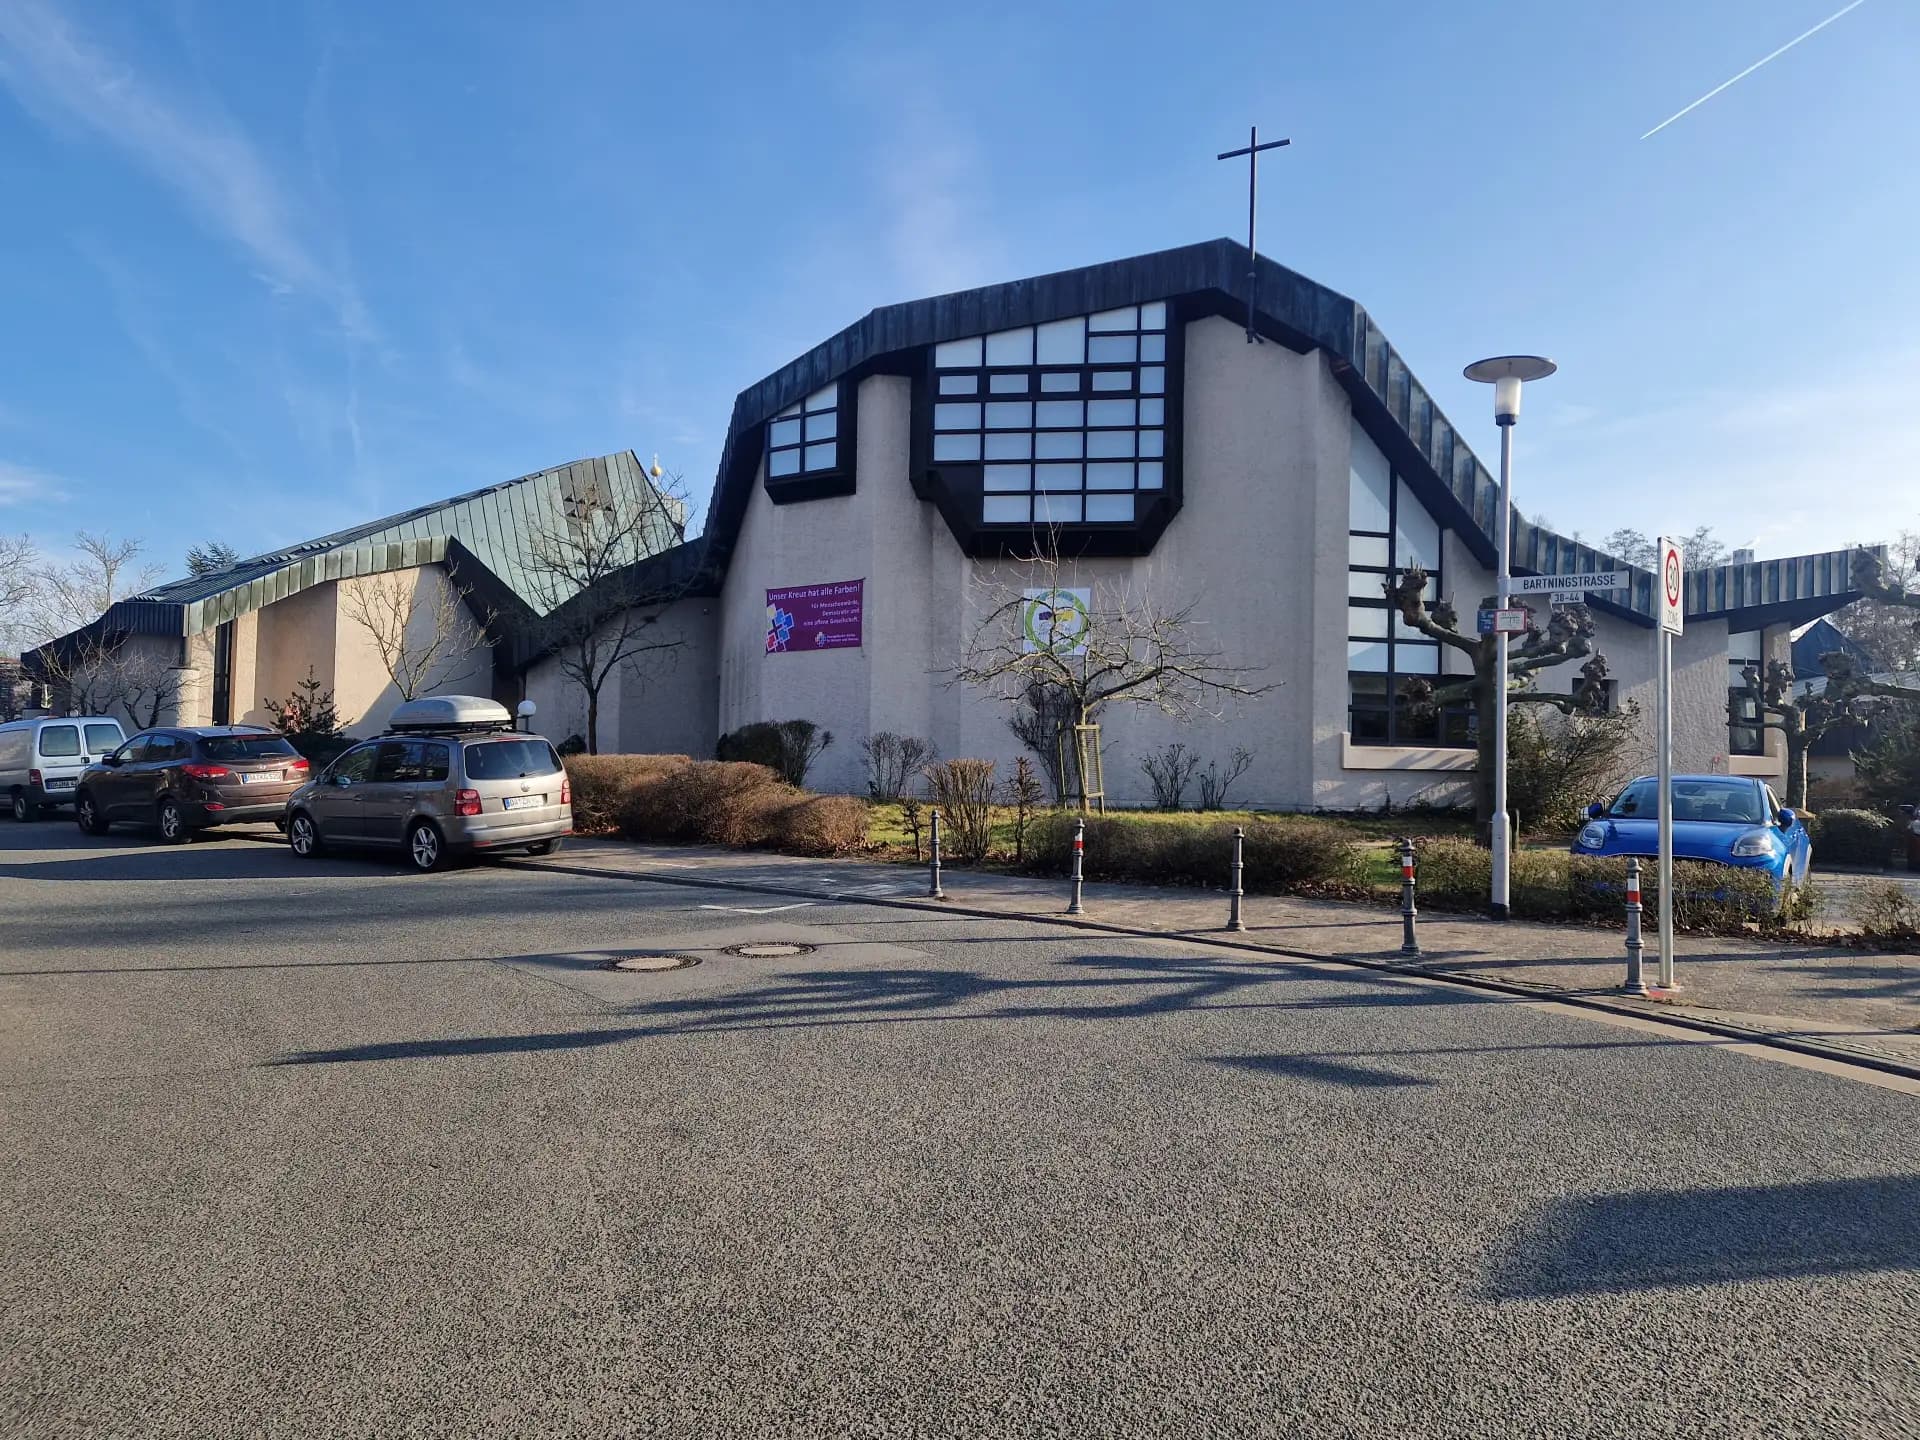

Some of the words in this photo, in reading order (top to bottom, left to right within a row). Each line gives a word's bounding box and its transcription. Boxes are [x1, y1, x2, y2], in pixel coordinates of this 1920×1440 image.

[1523, 574, 1616, 590] BARTNINGSTRASSE
[1669, 565, 1678, 591] 30
[768, 592, 787, 601] Unser
[788, 591, 807, 599] Kreuz
[807, 589, 820, 597] hat
[820, 588, 833, 596] alle
[834, 583, 860, 595] Farben!
[1554, 593, 1580, 602] 38-44
